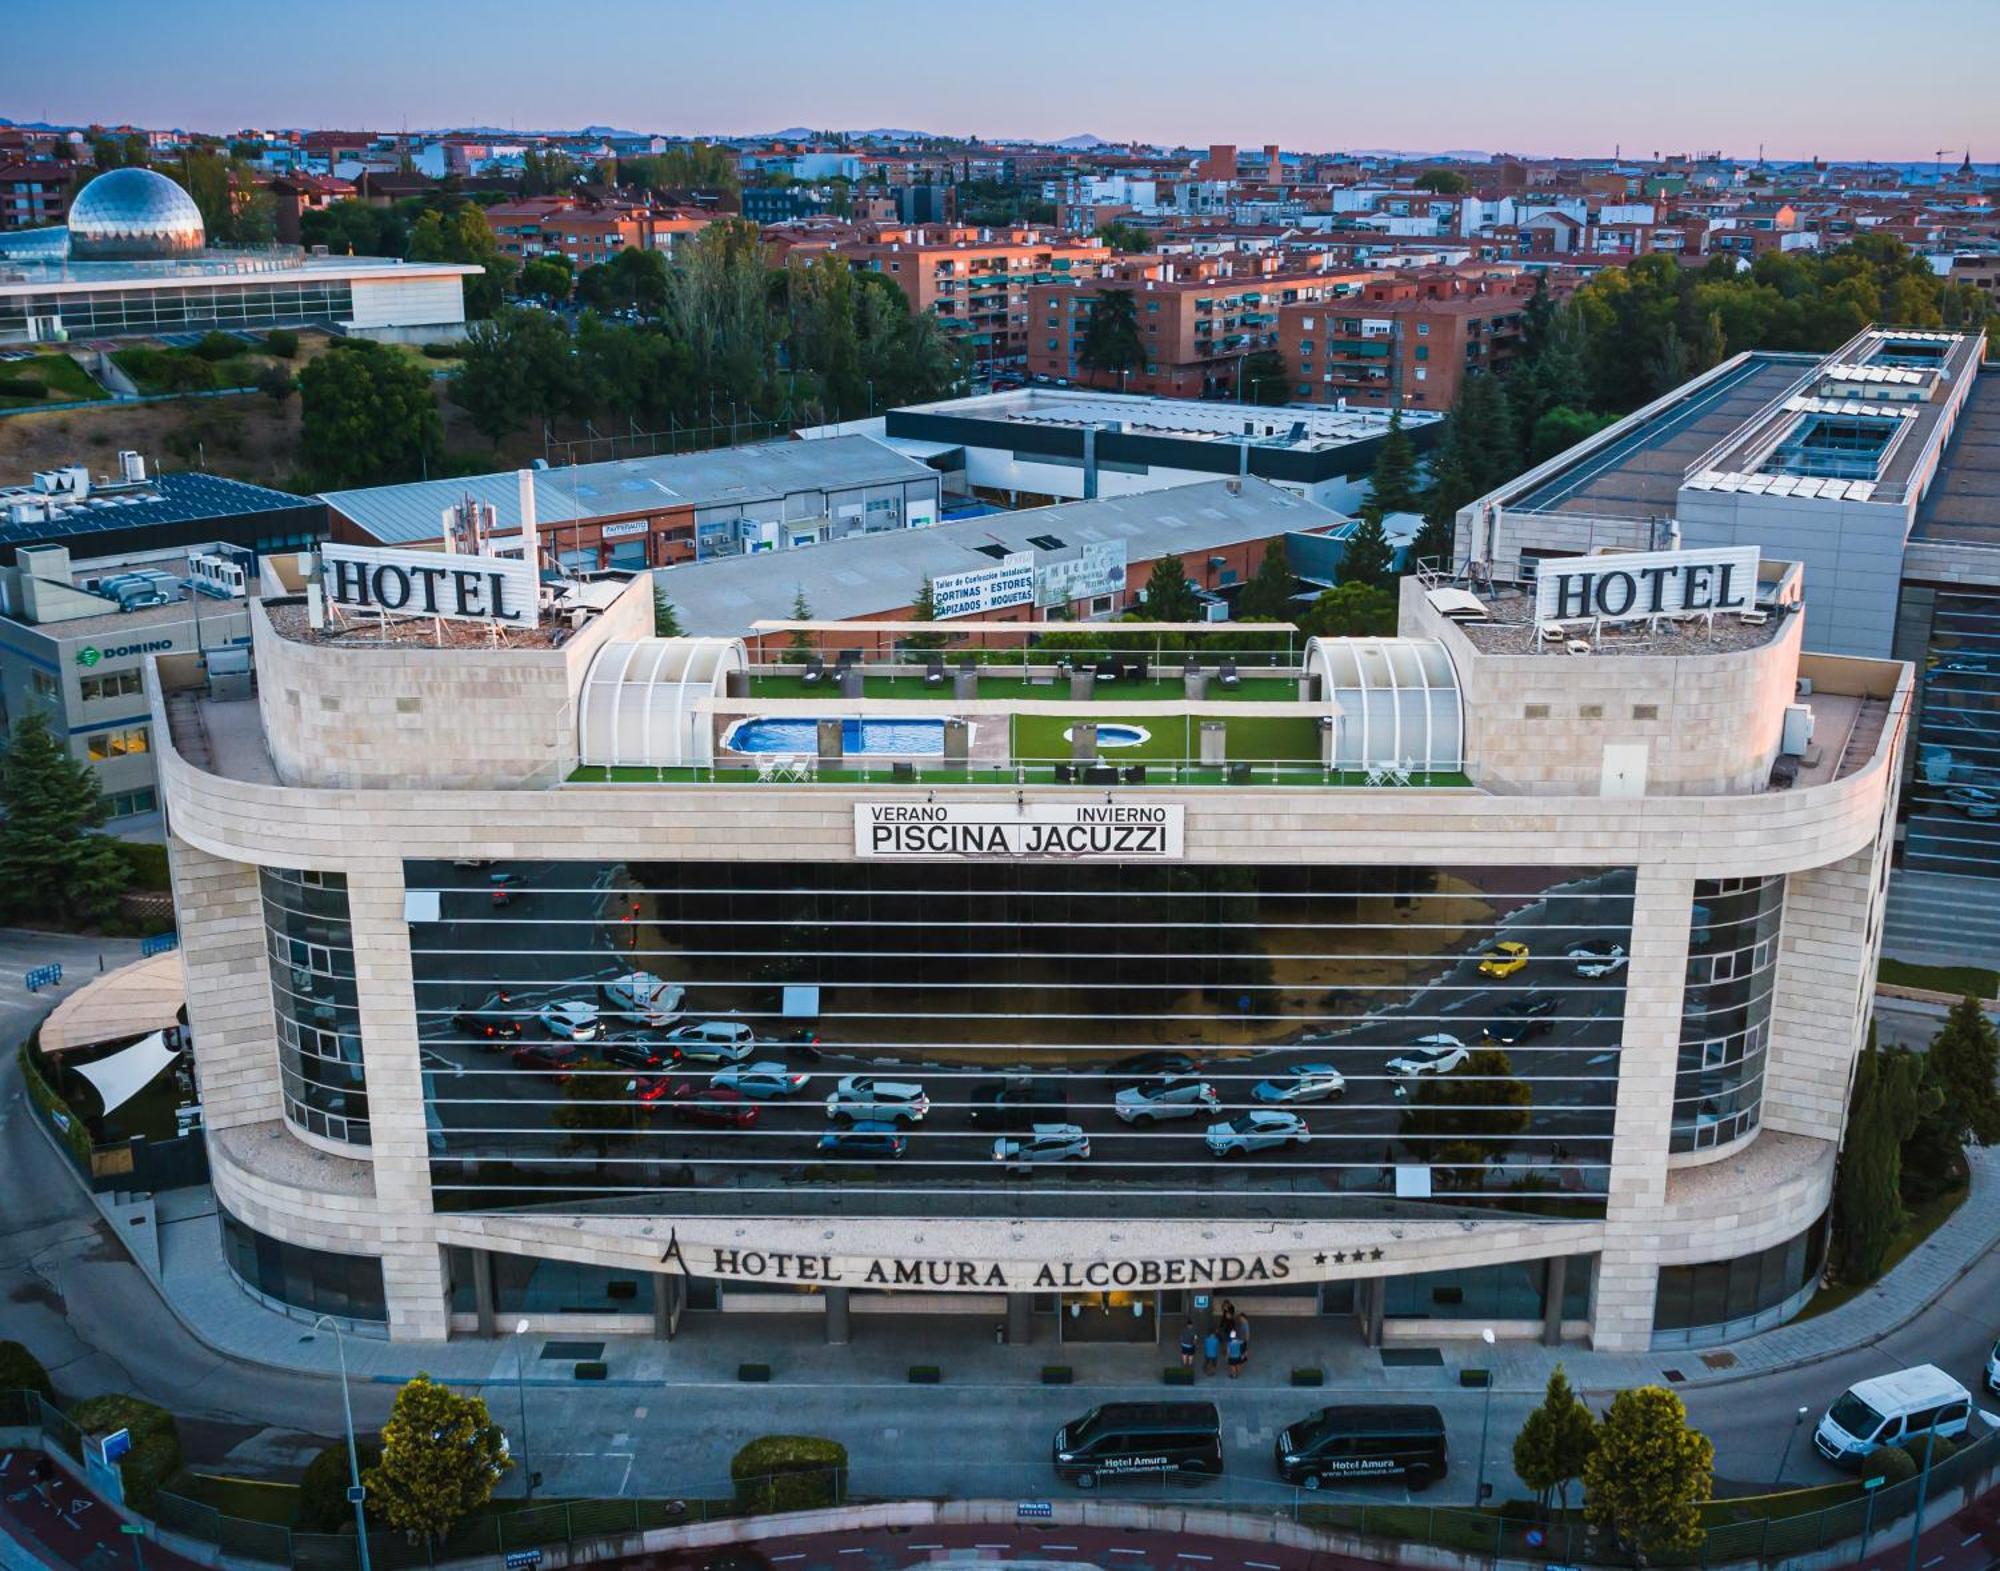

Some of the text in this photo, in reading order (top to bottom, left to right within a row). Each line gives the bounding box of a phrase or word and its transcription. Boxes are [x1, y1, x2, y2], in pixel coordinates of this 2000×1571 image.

[332, 559, 520, 619] HOTEL
[936, 581, 953, 589] Taller
[956, 578, 963, 586] de
[936, 577, 1032, 602] CORTINAS ESTORES
[1555, 563, 1745, 619] HOTEL
[936, 591, 1032, 616] TAPIZADOS MOQUETAS
[104, 639, 173, 659] DOMINO
[871, 807, 1166, 822] VERANO INVIERNO
[872, 825, 1167, 852] PISCINA JACUZZI
[713, 1249, 842, 1282] HOTEL
[864, 1259, 1009, 1287] AMURA
[1033, 1254, 1291, 1287] ALCOBENDAS
[1105, 1457, 1168, 1467] Hotel Amura
[1332, 1460, 1394, 1470] Hotel Amura
